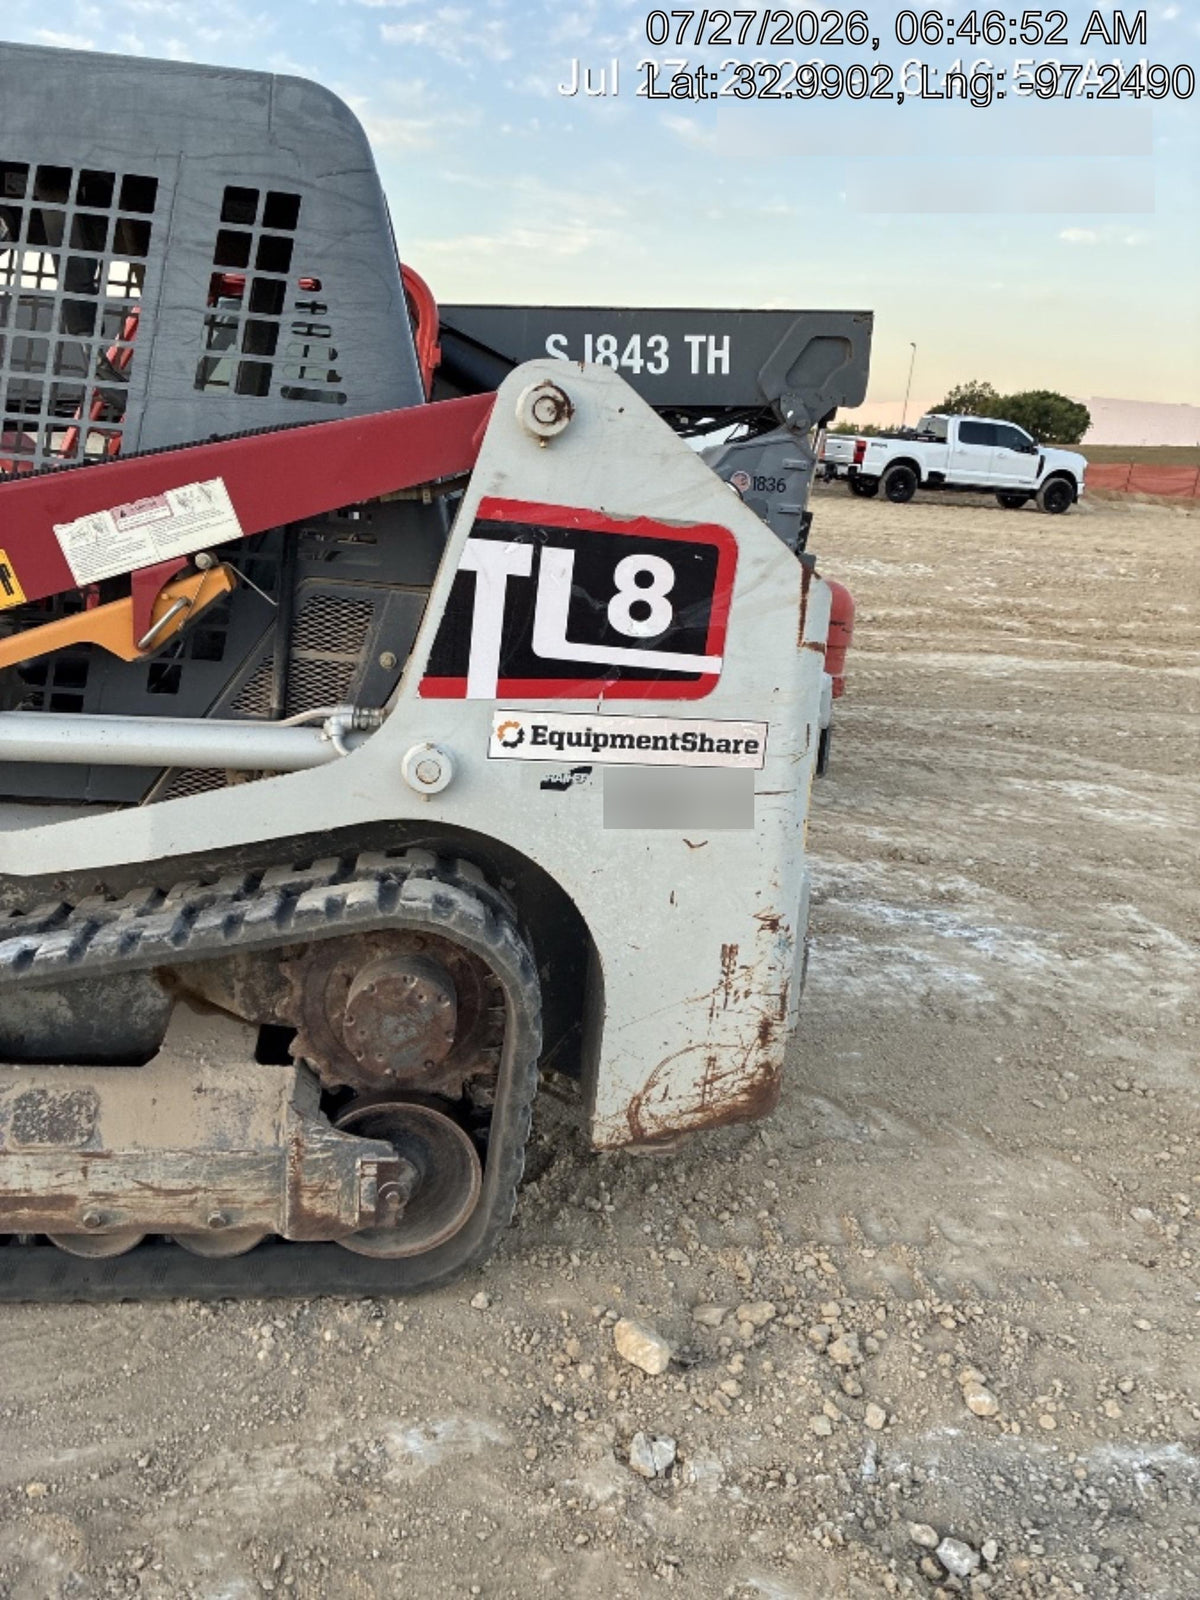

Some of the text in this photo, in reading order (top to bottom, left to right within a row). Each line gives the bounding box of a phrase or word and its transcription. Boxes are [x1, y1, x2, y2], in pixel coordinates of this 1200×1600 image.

[684, 335, 730, 375] TH
[752, 476, 787, 493] 1836
[458, 538, 723, 700] TL8
[530, 725, 760, 755] EquipmentShare
